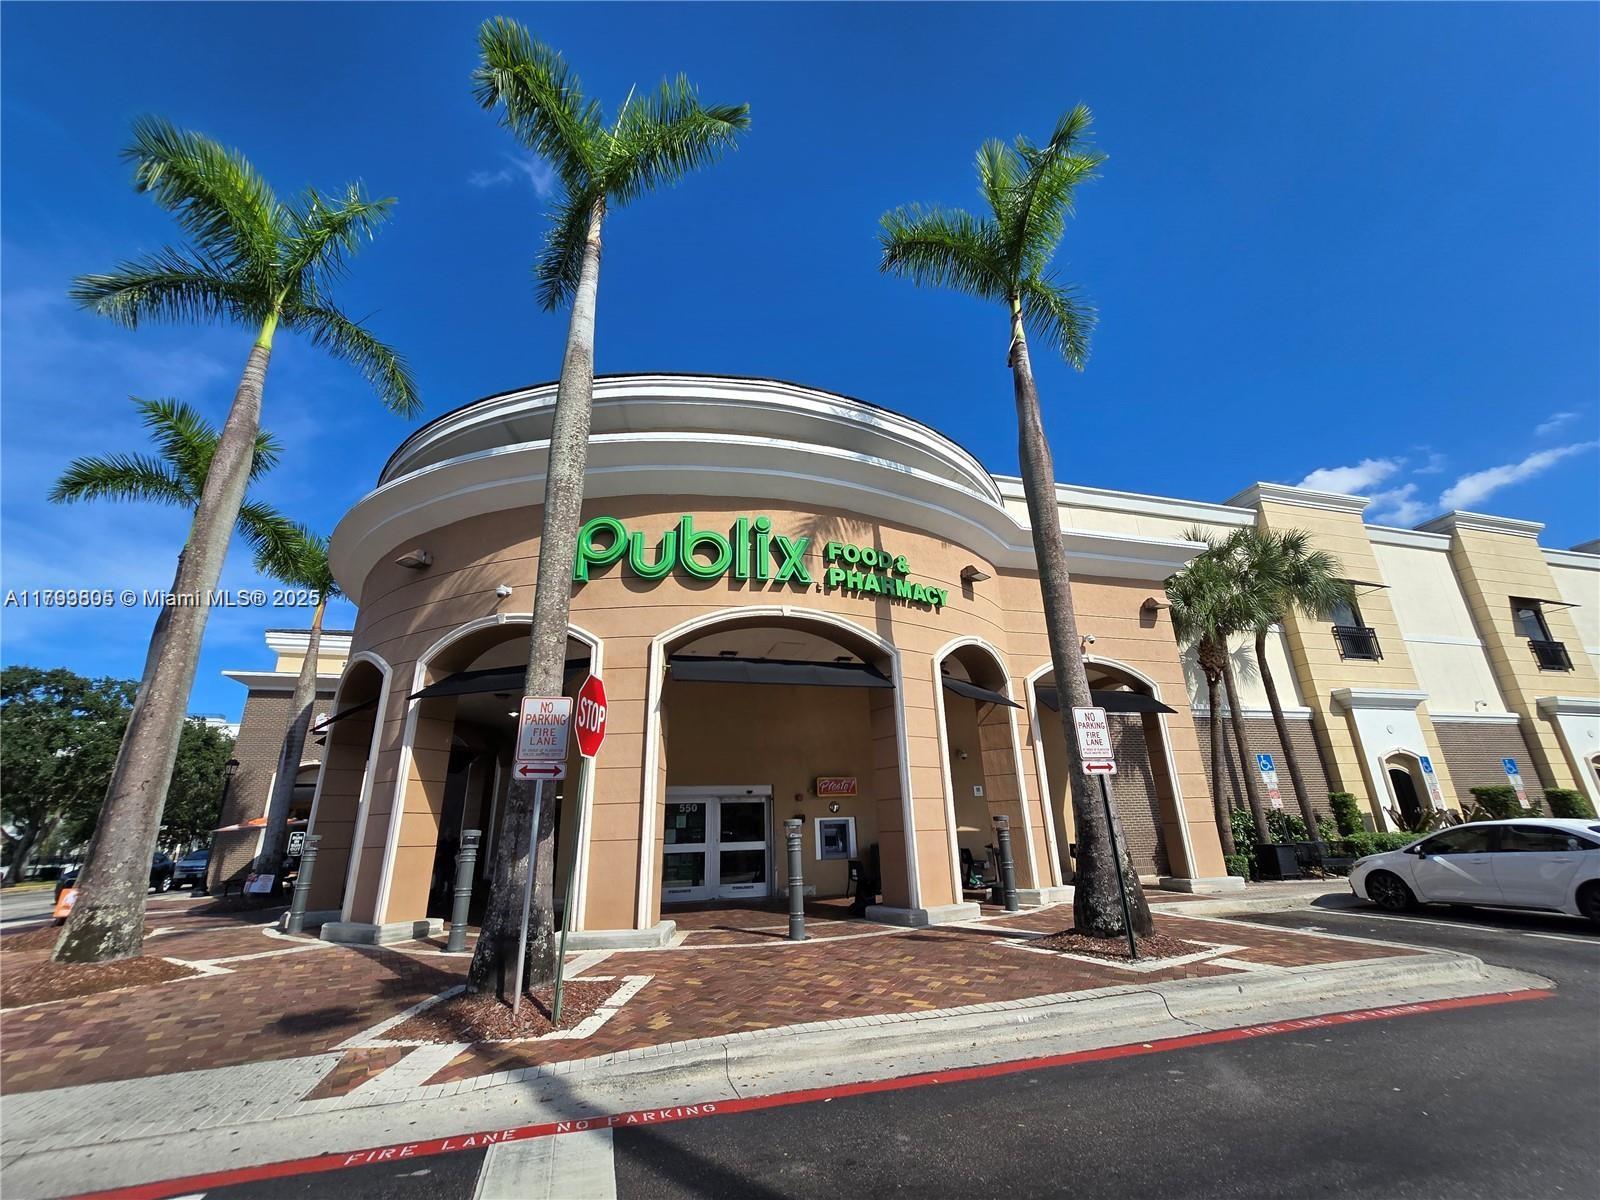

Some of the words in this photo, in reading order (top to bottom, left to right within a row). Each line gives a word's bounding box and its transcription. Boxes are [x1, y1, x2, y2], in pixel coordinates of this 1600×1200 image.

[572, 514, 812, 584] Publix
[826, 541, 893, 569] FOOD
[895, 555, 911, 575] &
[827, 567, 949, 608] PHARMACY
[540, 702, 554, 714] NO
[525, 714, 566, 725] PARKING
[578, 697, 606, 733] STOP
[1084, 712, 1096, 721] NO
[533, 728, 556, 737] FIRE
[529, 737, 558, 746] LANE
[679, 804, 698, 813] 550
[344, 1145, 418, 1165] FIRE
[441, 1129, 516, 1150] LANE
[556, 1120, 589, 1133] NO
[607, 1104, 717, 1126] PARKING
